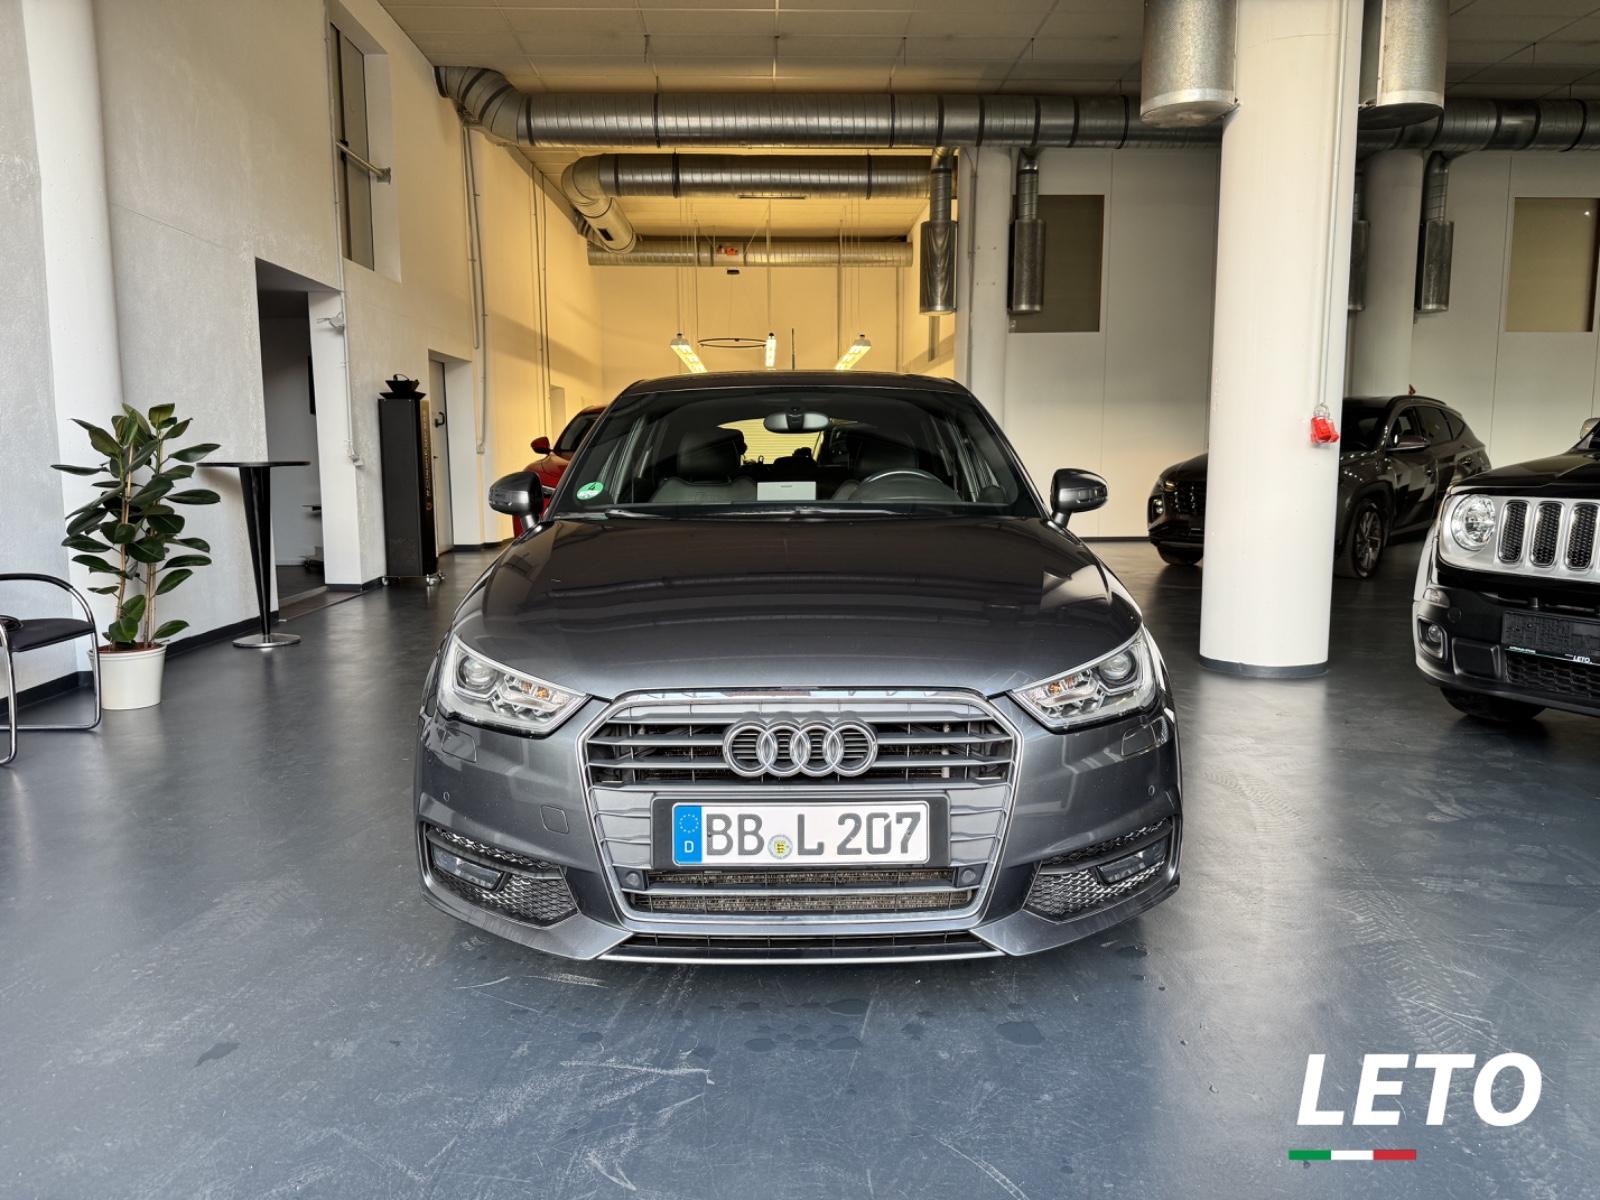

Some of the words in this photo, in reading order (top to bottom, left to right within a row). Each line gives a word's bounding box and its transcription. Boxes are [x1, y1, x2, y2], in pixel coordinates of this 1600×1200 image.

[683, 840, 695, 853] D
[705, 813, 765, 856] BB
[797, 813, 824, 856] L
[836, 811, 922, 856] 207
